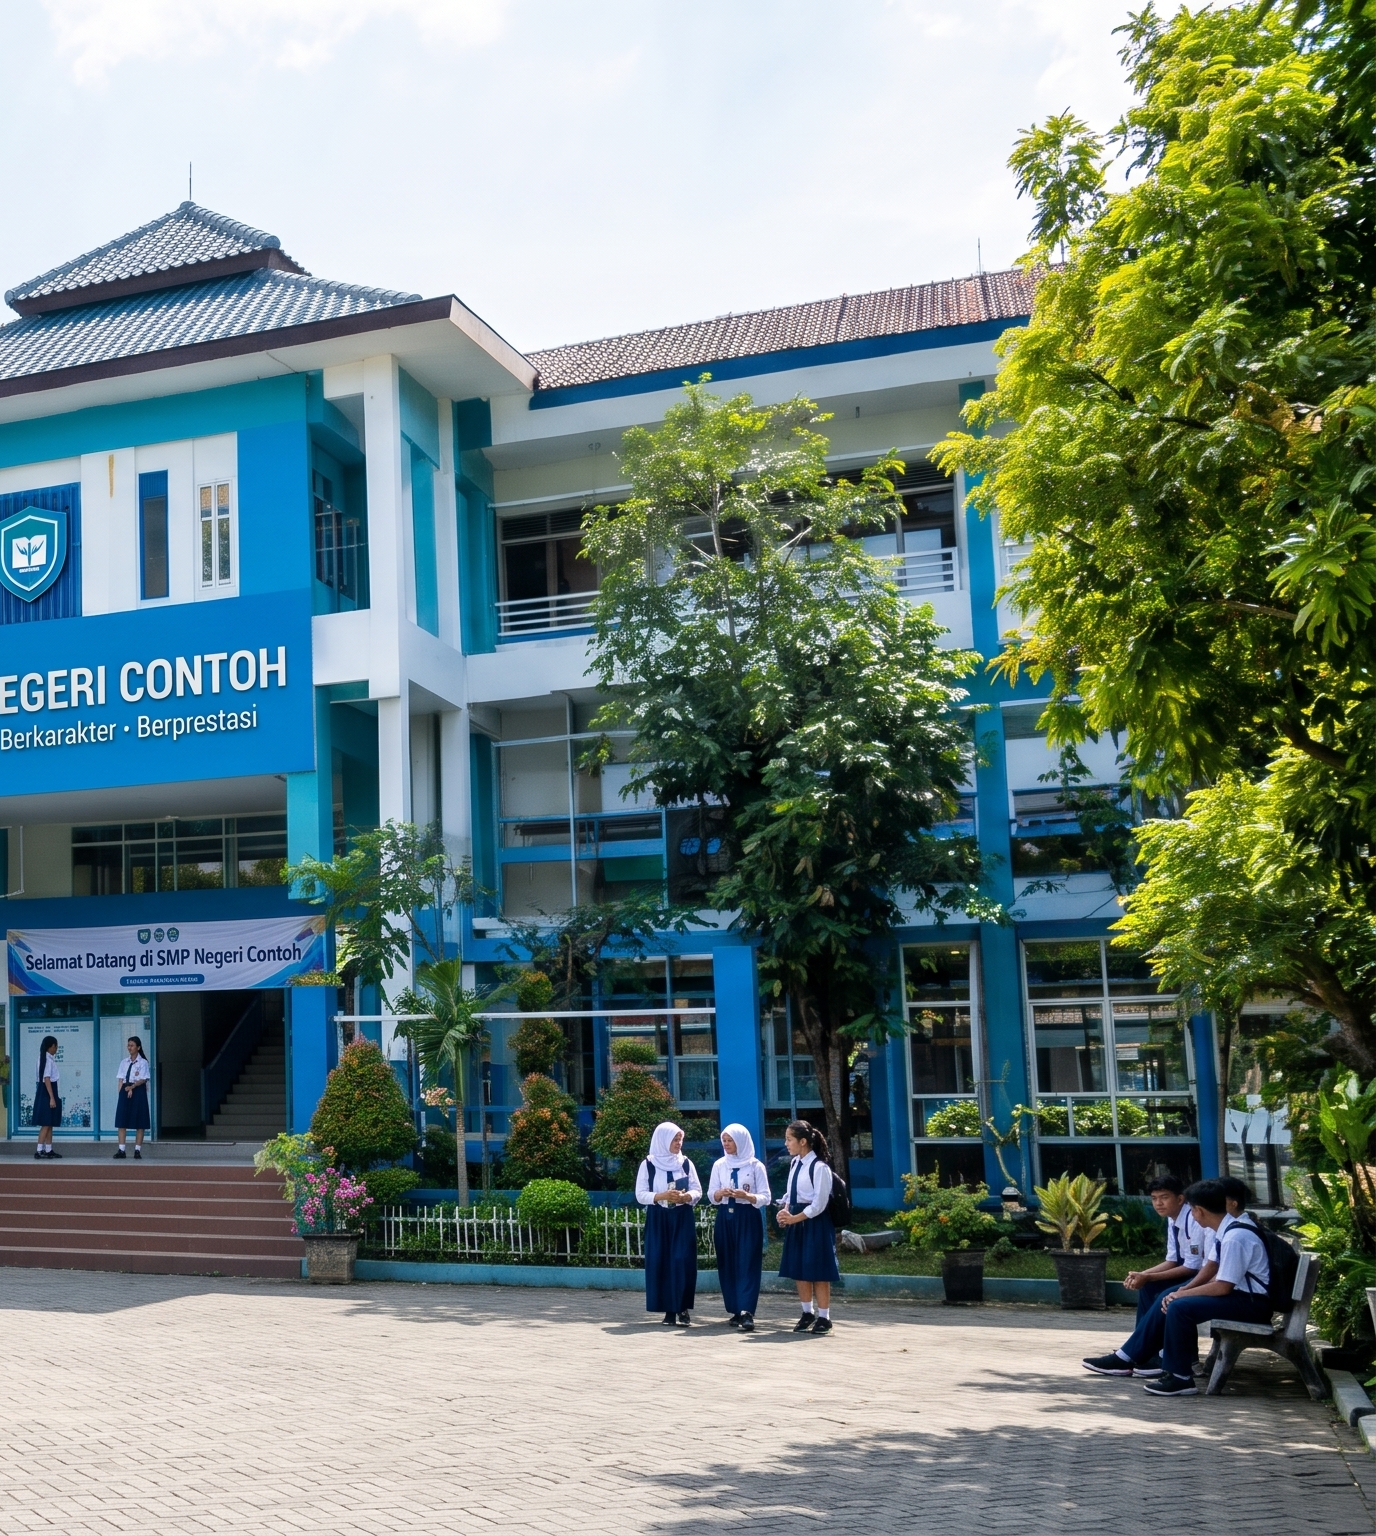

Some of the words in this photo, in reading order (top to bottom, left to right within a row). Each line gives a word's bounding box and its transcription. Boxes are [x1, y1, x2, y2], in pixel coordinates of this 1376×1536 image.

[120, 646, 286, 702] CONTOH
[0, 720, 116, 750] Berkarakter
[137, 703, 257, 740] Berprestasi
[25, 953, 83, 970] Selamat
[86, 953, 136, 972] Datang
[140, 949, 153, 967] di
[157, 948, 190, 966] SMP
[194, 946, 243, 969] Negeri
[247, 943, 301, 962] Contoh
